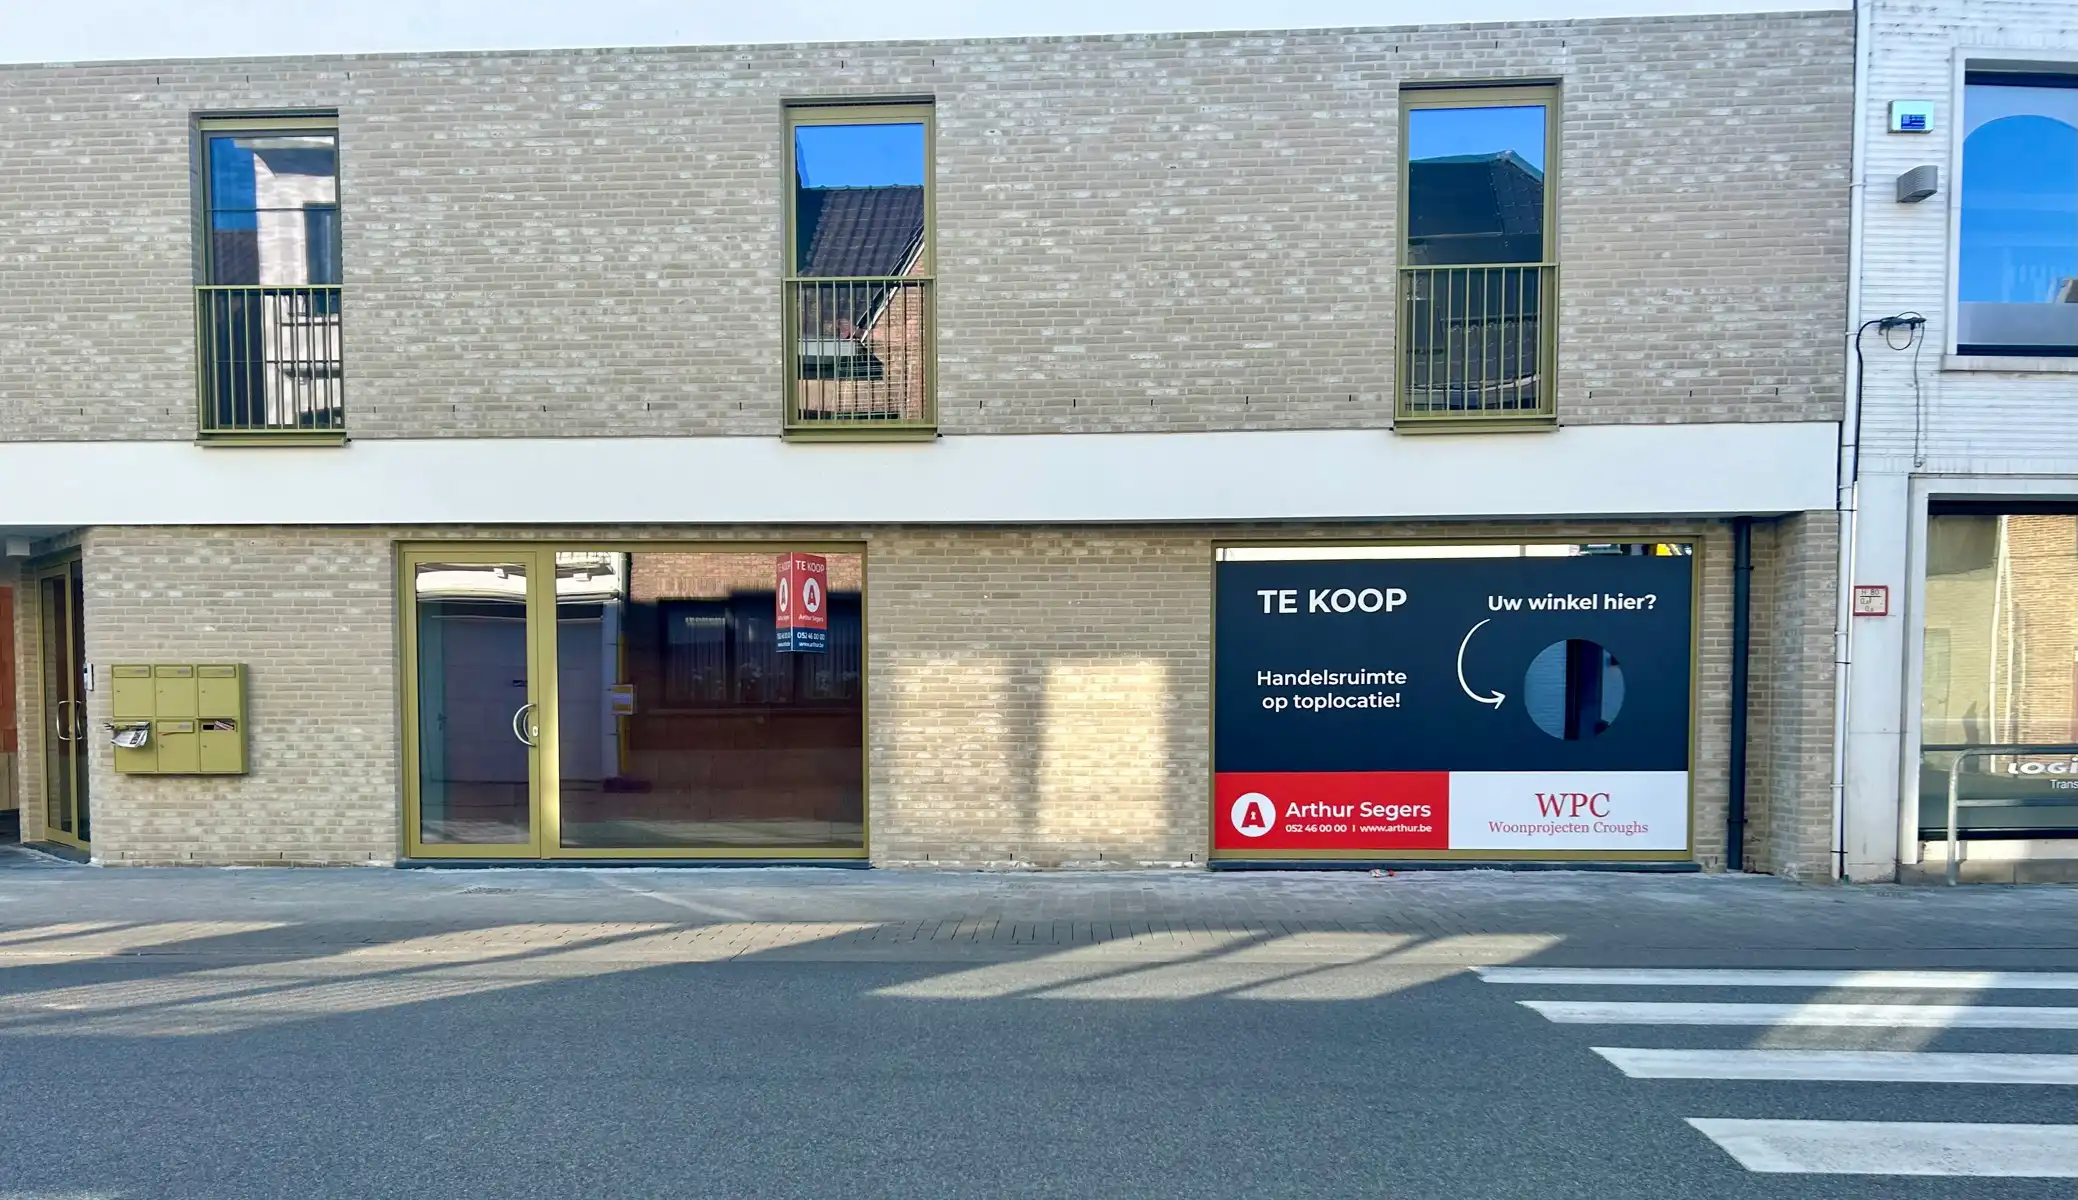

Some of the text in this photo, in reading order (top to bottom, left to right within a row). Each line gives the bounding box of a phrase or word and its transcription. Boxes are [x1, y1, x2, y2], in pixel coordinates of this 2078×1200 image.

[795, 560, 825, 573] TE KOOP
[1257, 588, 1407, 613] TE KOOP
[1488, 593, 1657, 611] Uw winkel hier?
[1257, 669, 1408, 686] Handelsruimte
[1262, 692, 1401, 712] op toplocatie!
[1285, 801, 1432, 821] Arthur Segers
[1535, 792, 1611, 818] WPC
[1241, 802, 1265, 828] A
[1285, 824, 1303, 833] 052
[1305, 824, 1318, 833] 46
[1319, 824, 1332, 833] 00
[1333, 824, 1347, 833] 00
[1359, 824, 1433, 833] www.arthur.be
[1488, 821, 1649, 836] Woonprojecten Croughs
